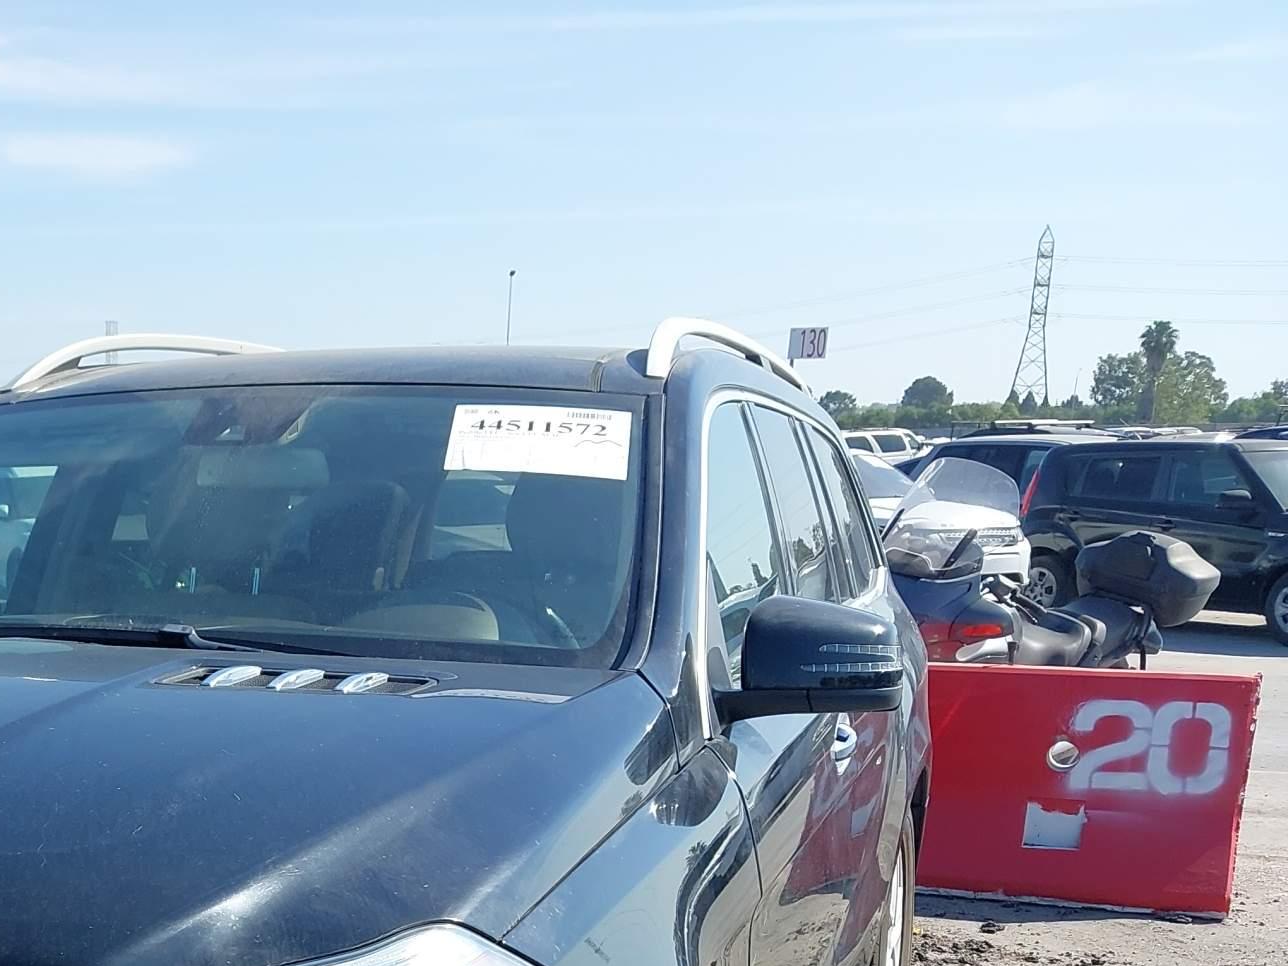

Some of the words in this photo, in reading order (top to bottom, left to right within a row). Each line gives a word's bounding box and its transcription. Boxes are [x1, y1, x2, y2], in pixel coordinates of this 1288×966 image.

[800, 328, 827, 358] 130
[471, 418, 608, 436] 44511572
[1068, 698, 1232, 797] 20
